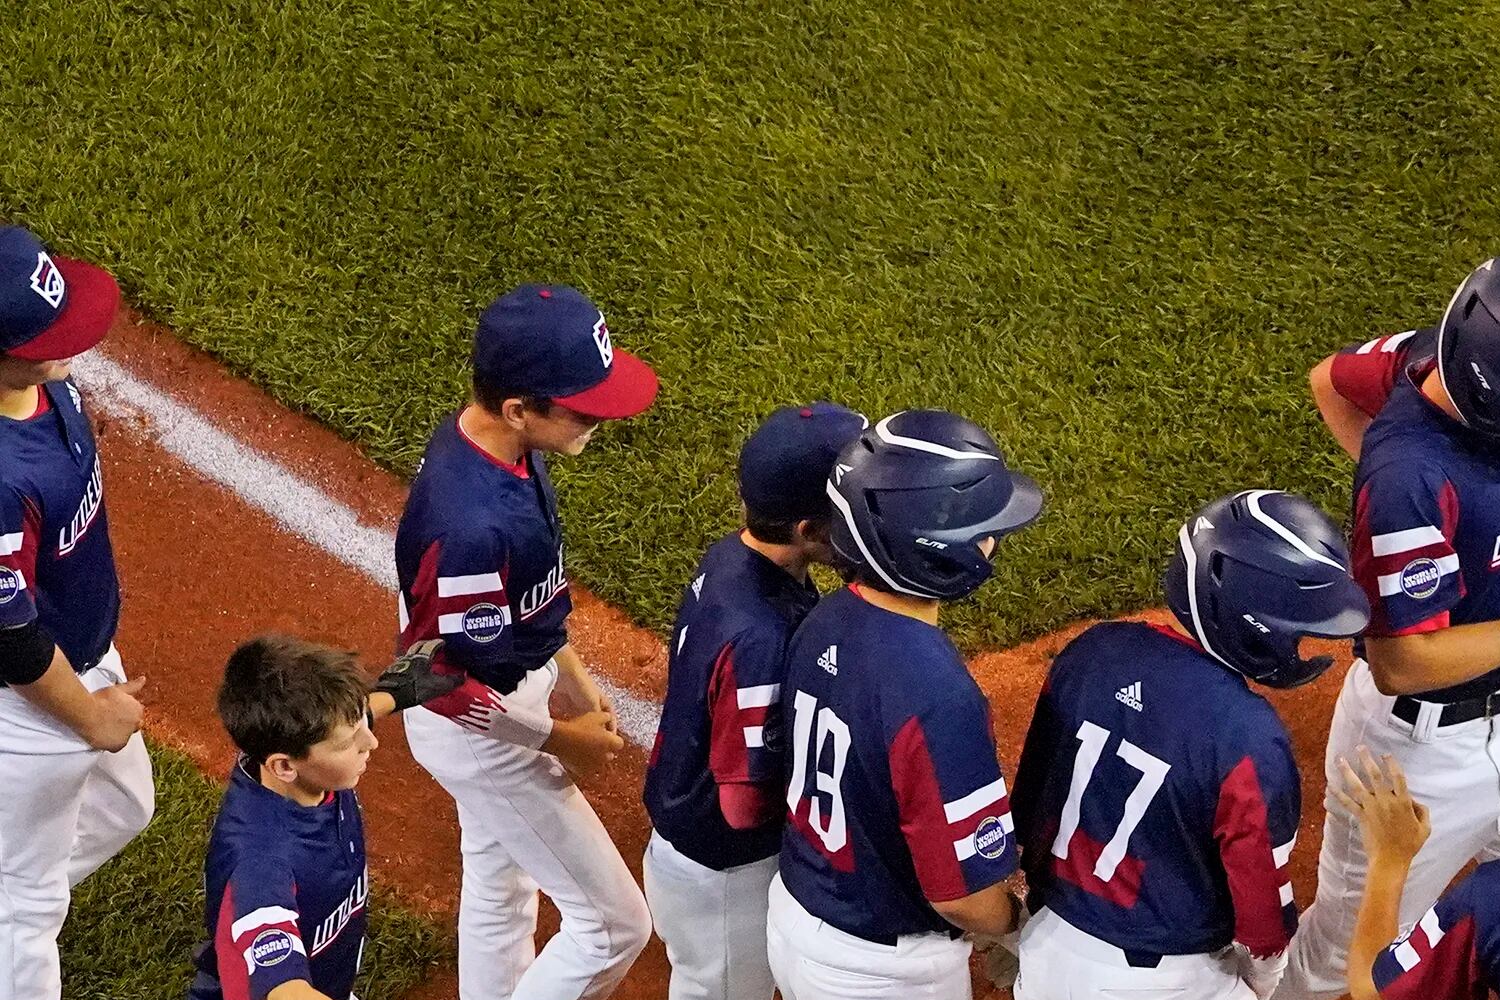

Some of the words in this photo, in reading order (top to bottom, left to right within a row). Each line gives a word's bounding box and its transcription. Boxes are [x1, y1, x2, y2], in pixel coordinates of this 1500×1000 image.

[915, 537, 948, 550] ELITE
[466, 614, 501, 625] WORLD
[1115, 691, 1144, 712] adidas
[787, 690, 851, 852] 19
[1051, 720, 1172, 882] 17
